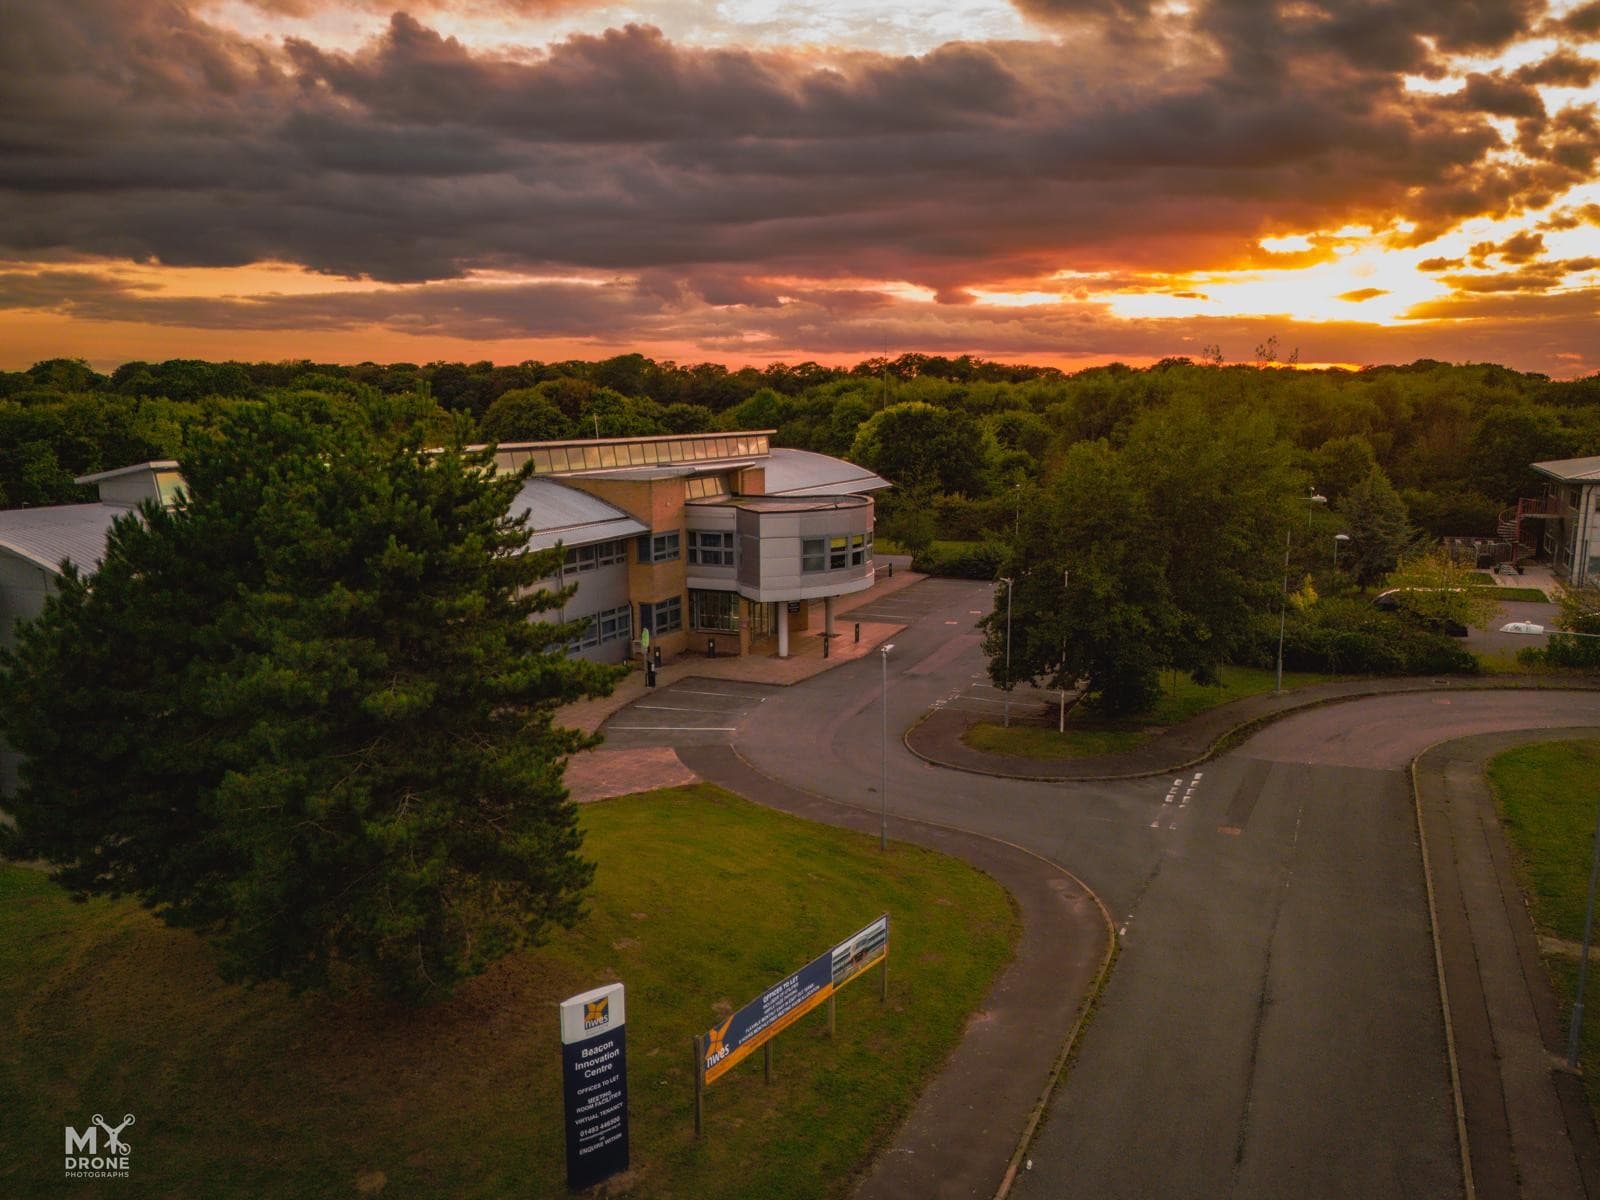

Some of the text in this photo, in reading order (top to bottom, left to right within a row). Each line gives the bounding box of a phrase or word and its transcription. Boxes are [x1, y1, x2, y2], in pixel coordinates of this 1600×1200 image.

[585, 1015, 608, 1029] nwes
[581, 1041, 613, 1058] Beacon
[707, 1044, 730, 1068] nwes
[575, 1048, 619, 1070] Innovation
[584, 1064, 612, 1078] Centre
[577, 1083, 601, 1095] OFFICES
[588, 1090, 611, 1104] MEETING
[576, 1091, 621, 1113] ROOM FACILITIES
[575, 1102, 623, 1125] VIRTUAL TENANCY
